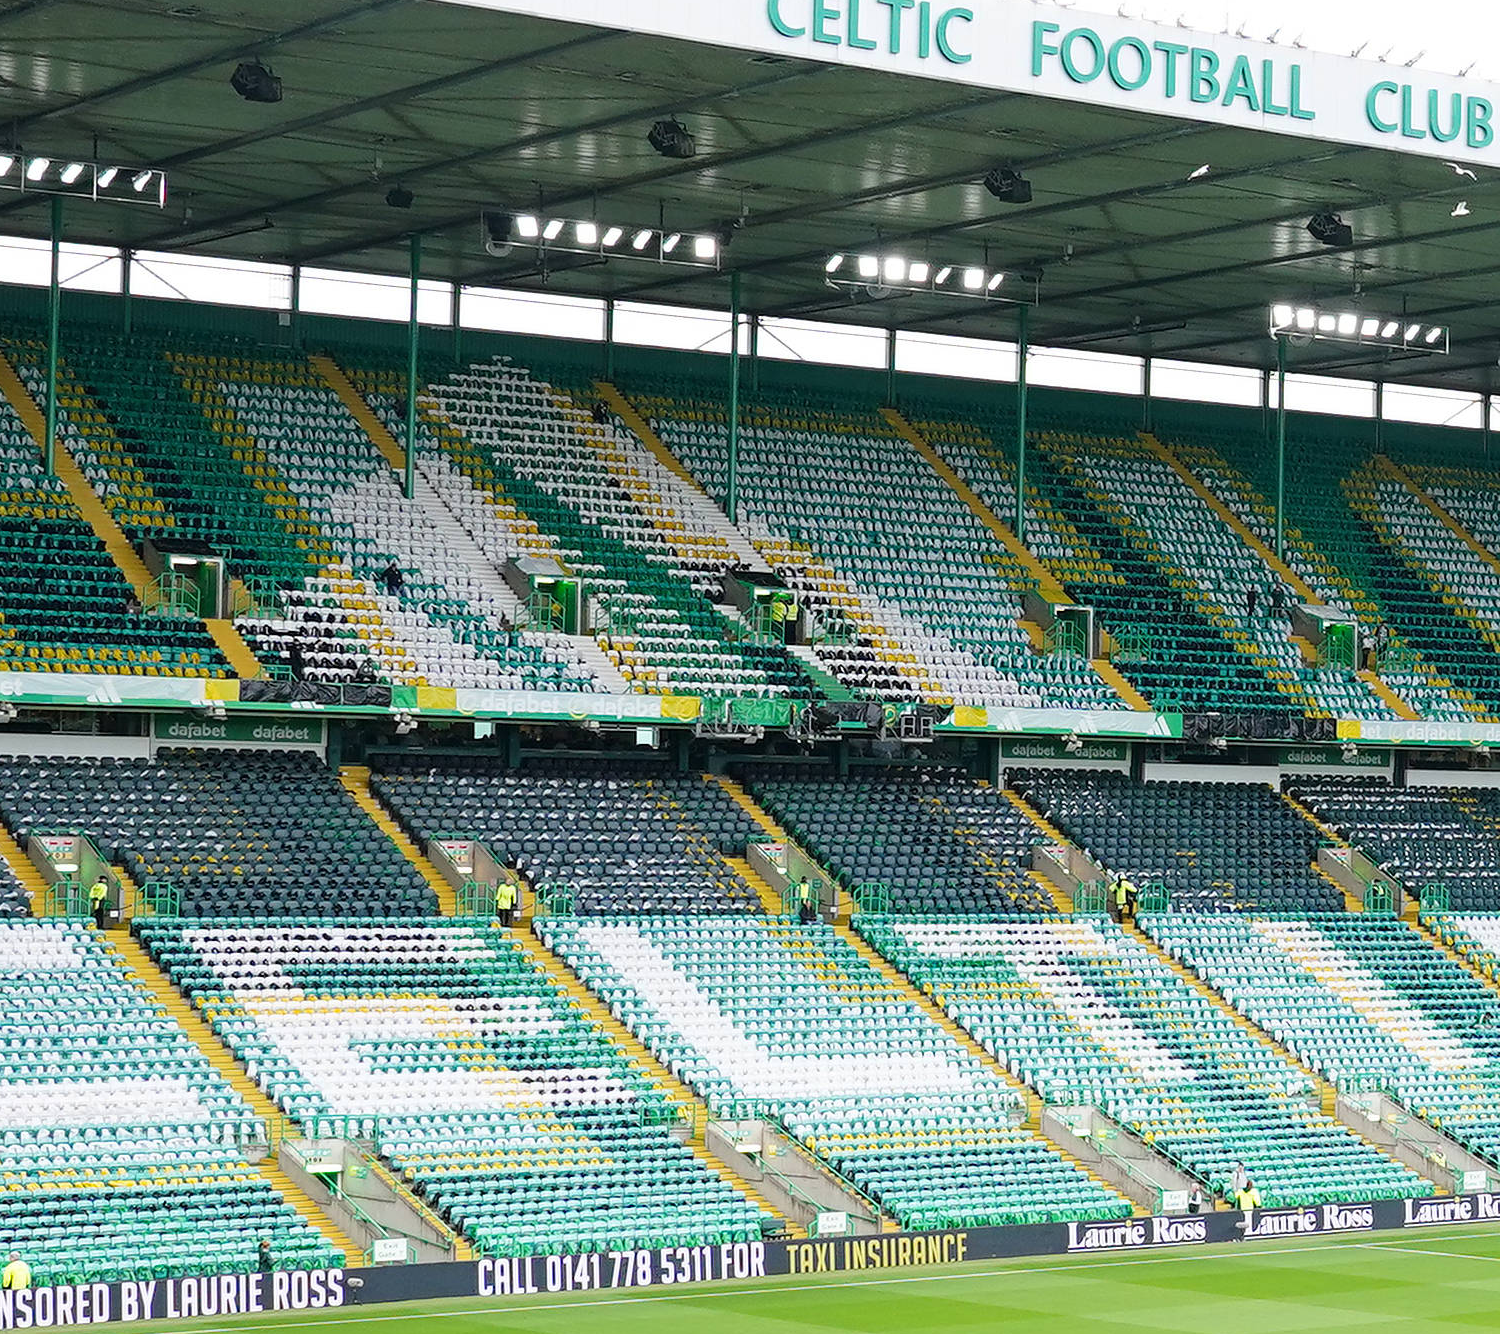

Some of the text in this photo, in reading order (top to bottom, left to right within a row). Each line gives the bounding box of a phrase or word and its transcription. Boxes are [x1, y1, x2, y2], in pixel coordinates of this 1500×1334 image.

[1031, 20, 1316, 122] FOOTBALL
[1366, 80, 1495, 149] CLUB
[169, 723, 309, 741] dafabet dafabet
[1405, 723, 1461, 742] dafabet
[1011, 744, 1054, 757] dafabet
[1242, 1204, 1374, 1236] Laurie Ross
[1403, 1197, 1472, 1224] Laurie
[1067, 1216, 1206, 1249] Laurie Ross
[478, 1241, 765, 1296] CALL 0141 778 5311 FOR
[786, 1233, 968, 1275] TAXI INSURANCE
[122, 1280, 156, 1321] BY
[166, 1272, 264, 1319] LAURIE
[273, 1268, 343, 1310] ROSS
